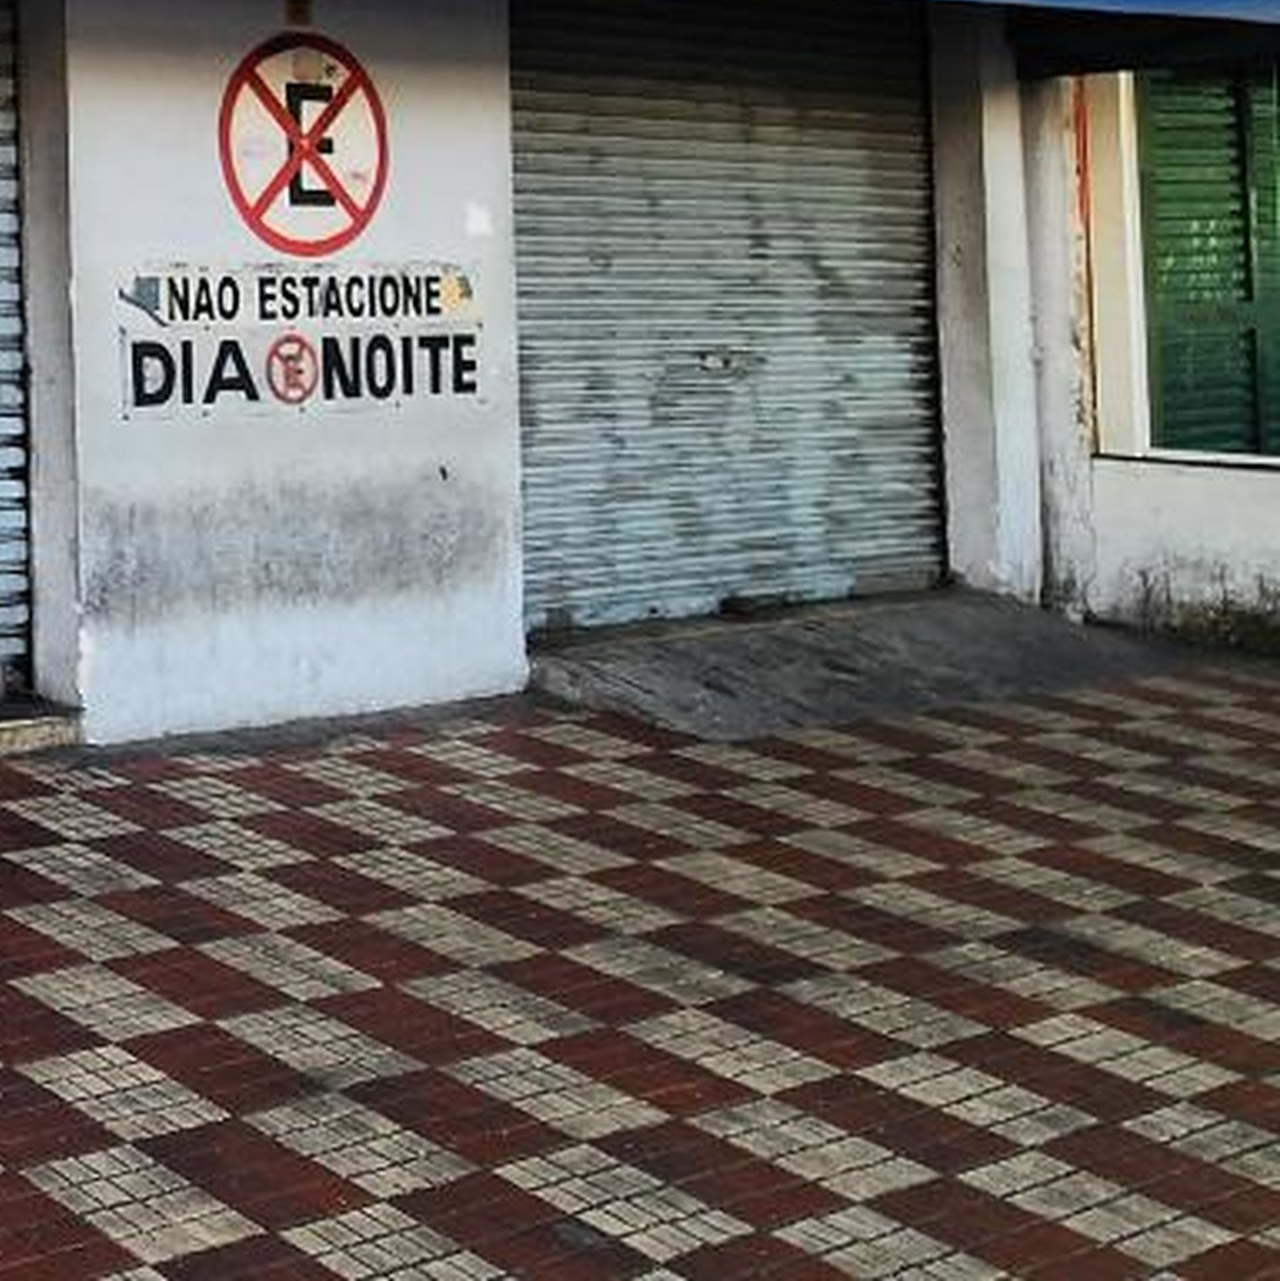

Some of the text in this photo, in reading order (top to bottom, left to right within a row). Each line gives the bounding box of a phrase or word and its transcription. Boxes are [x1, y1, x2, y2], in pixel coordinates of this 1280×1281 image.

[285, 82, 336, 206] E
[258, 274, 442, 321] ESTACIONE
[131, 339, 260, 407] DIA
[322, 333, 477, 400] NOITE
